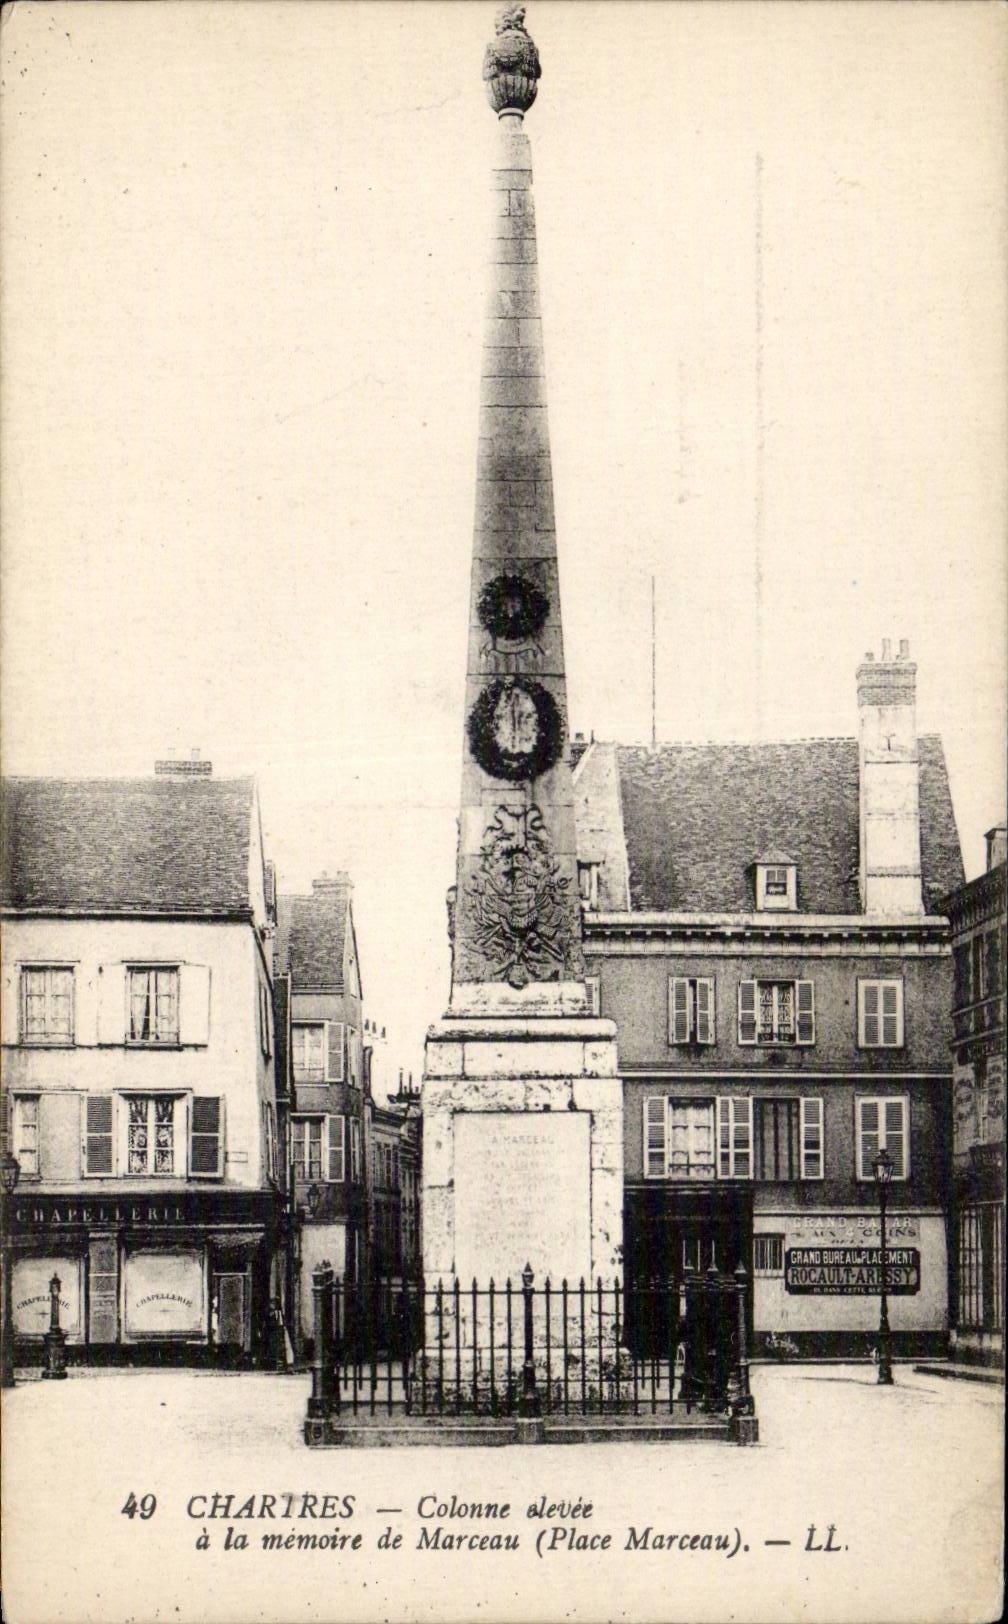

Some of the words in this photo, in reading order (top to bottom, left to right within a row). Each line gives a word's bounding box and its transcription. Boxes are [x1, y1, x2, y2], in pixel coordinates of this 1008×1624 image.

[16, 1207, 185, 1222] CHAPELLERIE
[857, 1217, 913, 1228] BAAR
[790, 1250, 821, 1265] GRAND
[823, 1250, 857, 1265] BUREAU
[861, 1250, 914, 1265] PLACEMENT
